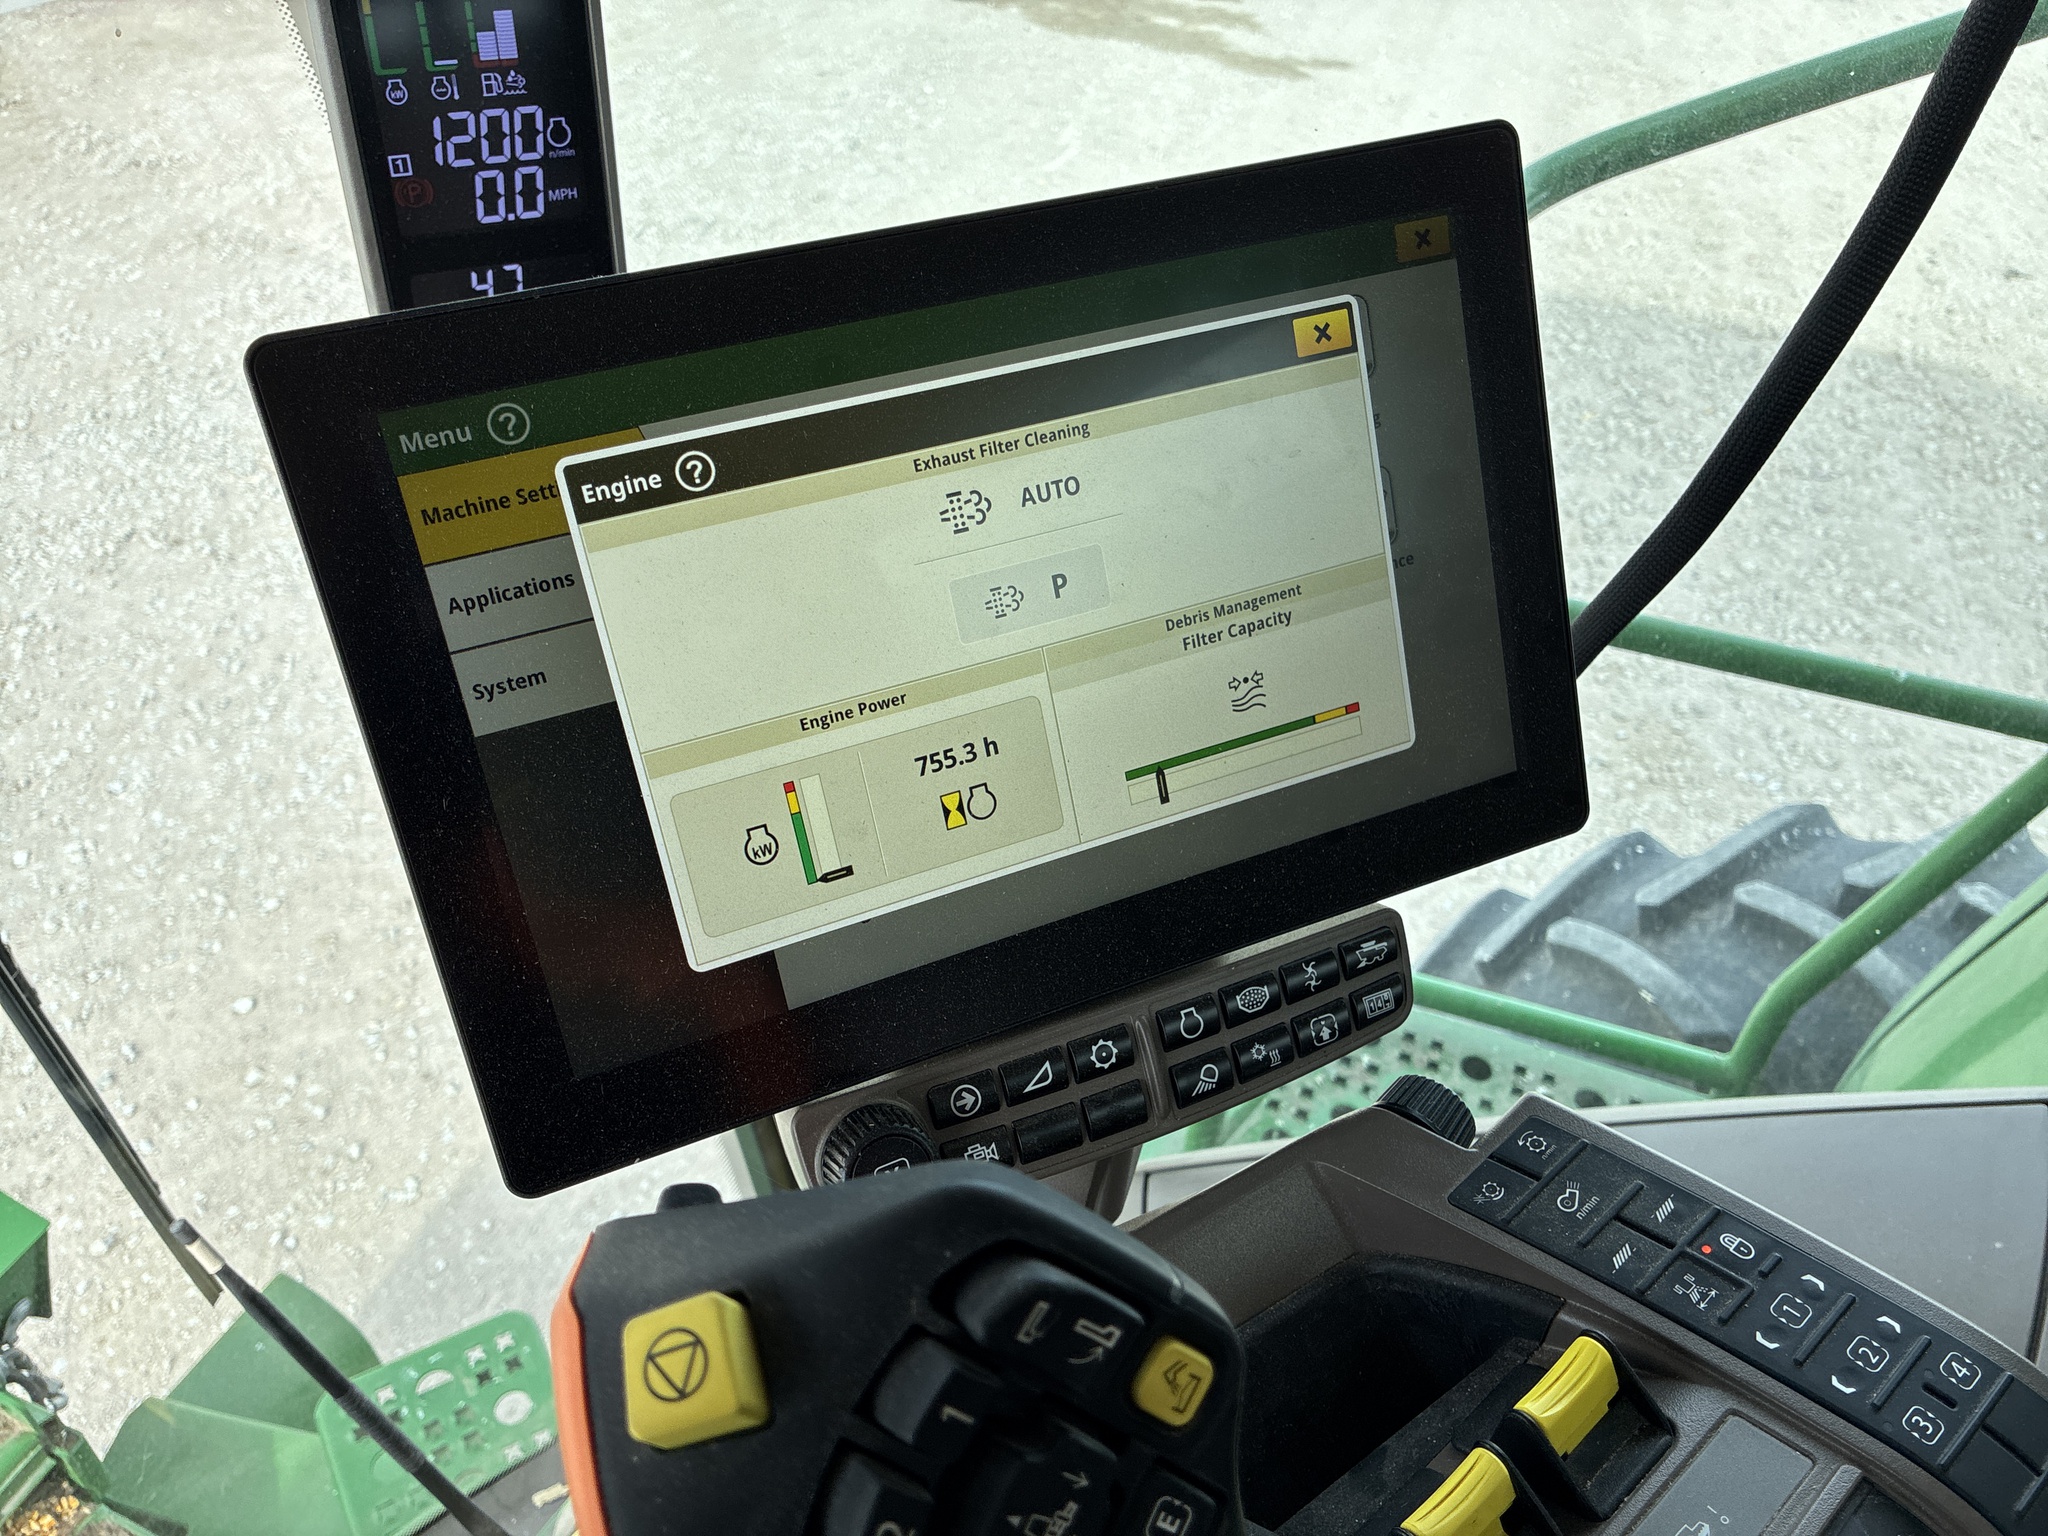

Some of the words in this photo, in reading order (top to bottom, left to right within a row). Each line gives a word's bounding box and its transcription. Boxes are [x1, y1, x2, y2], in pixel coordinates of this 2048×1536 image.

[433, 105, 545, 168] 1200
[474, 165, 545, 224] 0.0
[549, 187, 578, 203] MPH
[398, 424, 473, 454] Menu
[912, 447, 976, 473] Exhaust
[979, 437, 1020, 459] Filter
[1024, 422, 1091, 448] Cleaning
[581, 470, 663, 504] Engine
[1020, 476, 1081, 508] AUTO
[420, 491, 511, 527] Machine
[515, 480, 561, 506] Setti
[448, 571, 576, 616] Applications
[1051, 573, 1068, 599] P
[1165, 609, 1210, 632] Debris
[1213, 583, 1303, 620] Management
[1182, 627, 1224, 651] Filter
[1227, 609, 1293, 638] Capacity
[472, 669, 548, 703] System
[799, 707, 854, 732] Engine
[857, 692, 908, 716] Power
[914, 742, 978, 777] 755.3
[983, 736, 1000, 758] h
[751, 842, 774, 860] kW
[1575, 1195, 1600, 1220] n/min
[1782, 1304, 1802, 1318] 1
[1858, 1347, 1880, 1365] 2
[1950, 1361, 1971, 1378] 4
[939, 1404, 975, 1425] 1
[1911, 1415, 1933, 1435] 3
[1155, 1511, 1182, 1534] E
